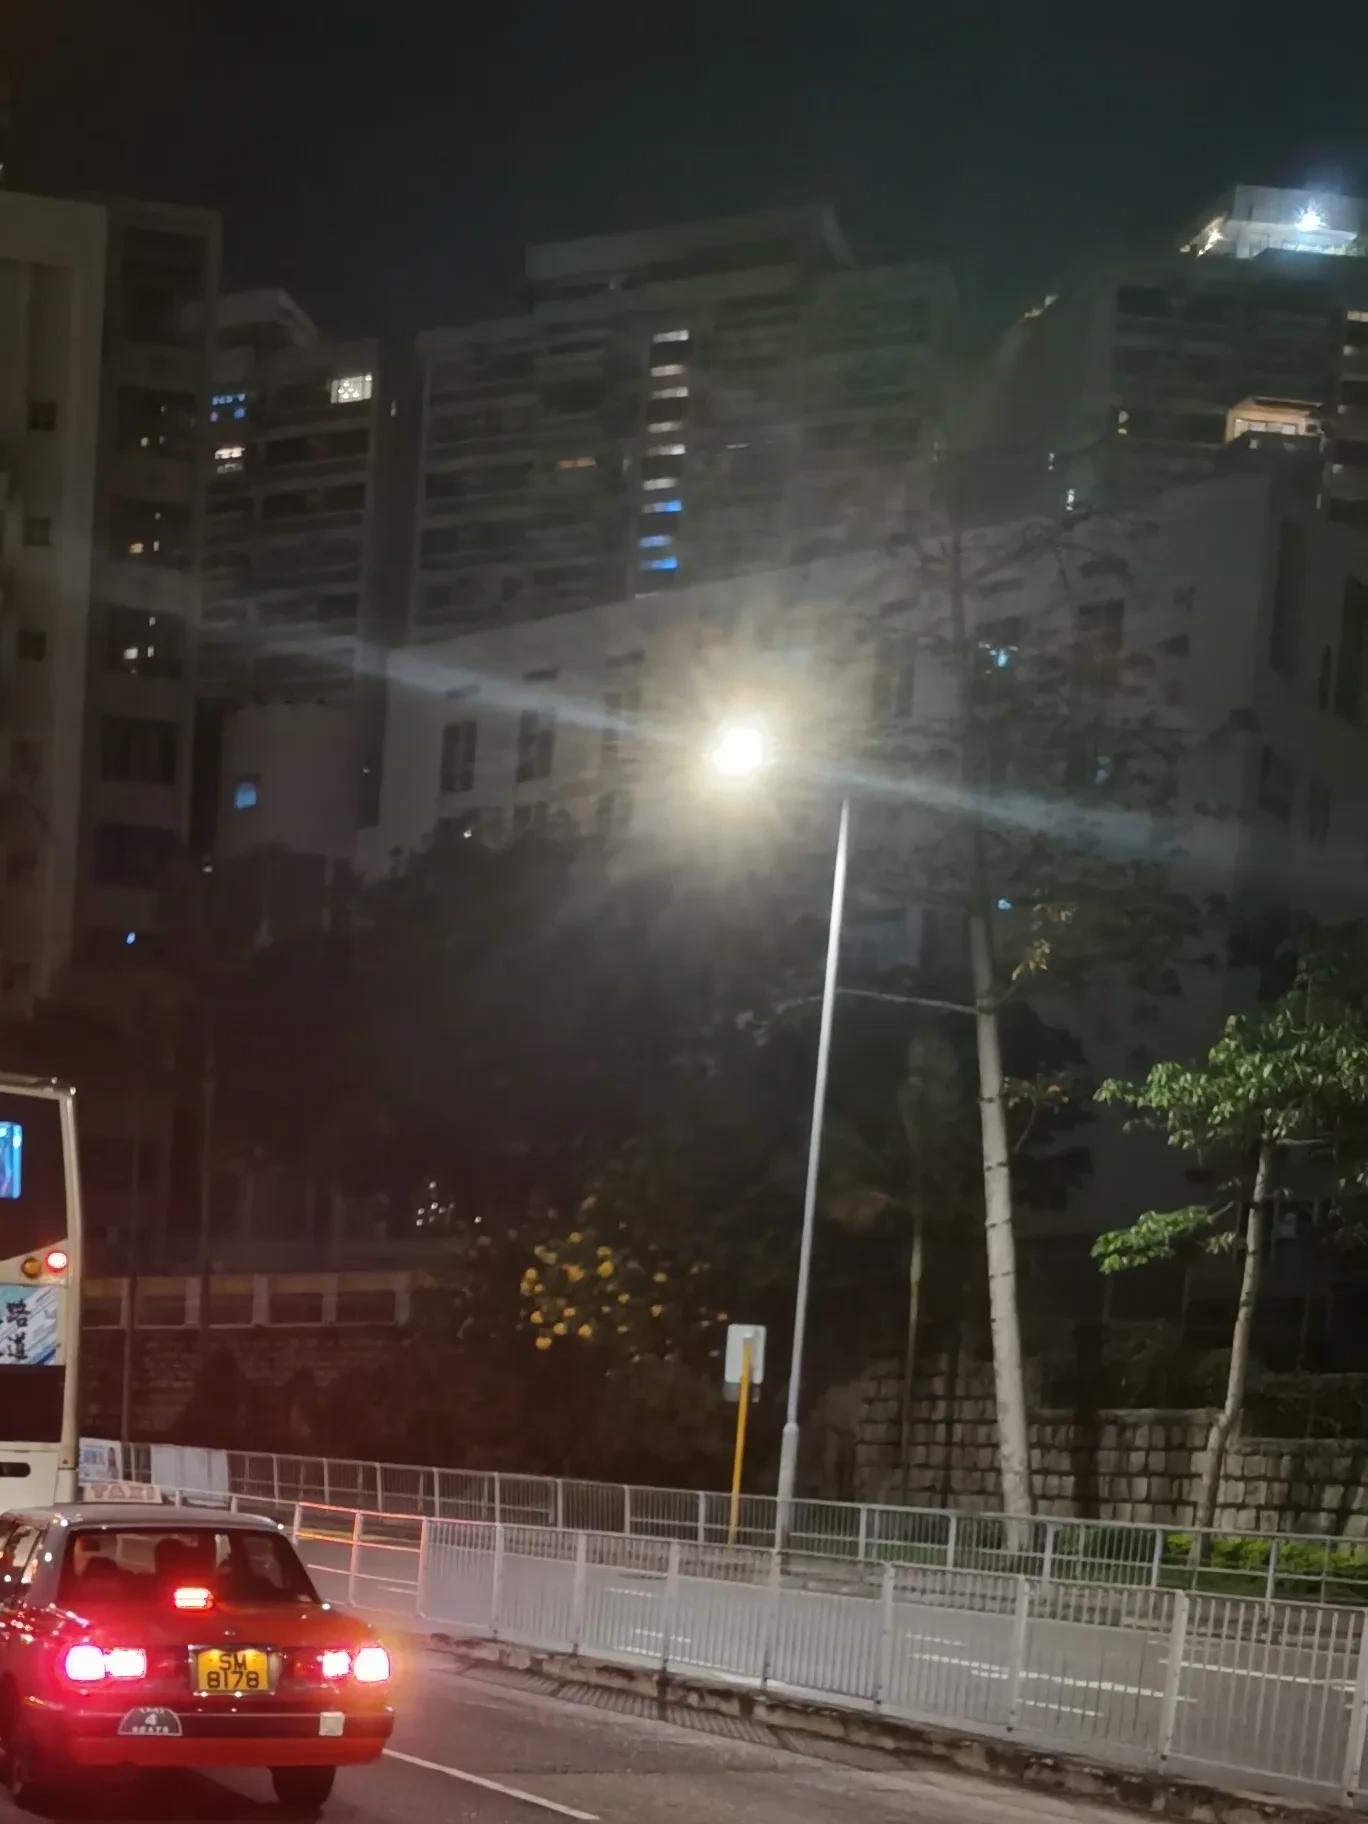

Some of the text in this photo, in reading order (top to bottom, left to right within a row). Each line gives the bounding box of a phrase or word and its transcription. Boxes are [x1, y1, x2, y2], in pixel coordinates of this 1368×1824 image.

[219, 1653, 247, 1670] SM
[207, 1671, 259, 1688] 8178
[145, 1713, 157, 1725] 4
